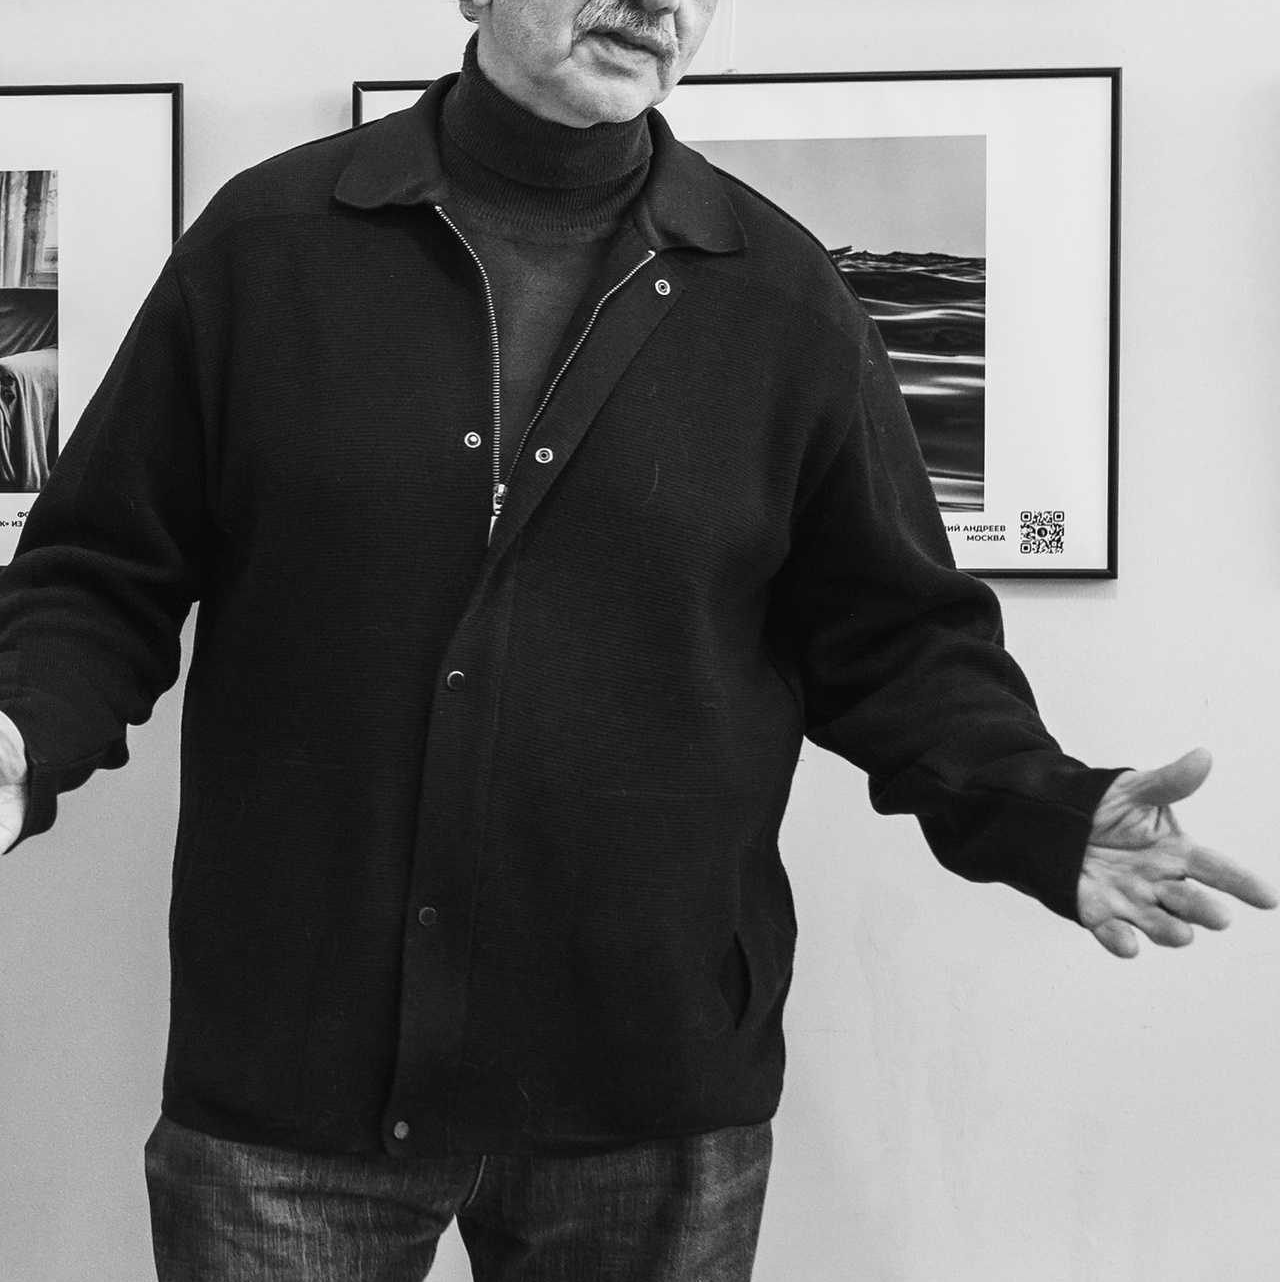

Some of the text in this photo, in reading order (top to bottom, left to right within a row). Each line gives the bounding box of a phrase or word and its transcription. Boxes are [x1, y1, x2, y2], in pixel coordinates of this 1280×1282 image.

[11, 520, 23, 528] ИЗ
[963, 525, 1007, 533] АНДРЕЕВ
[966, 534, 1007, 542] МОСКВА
